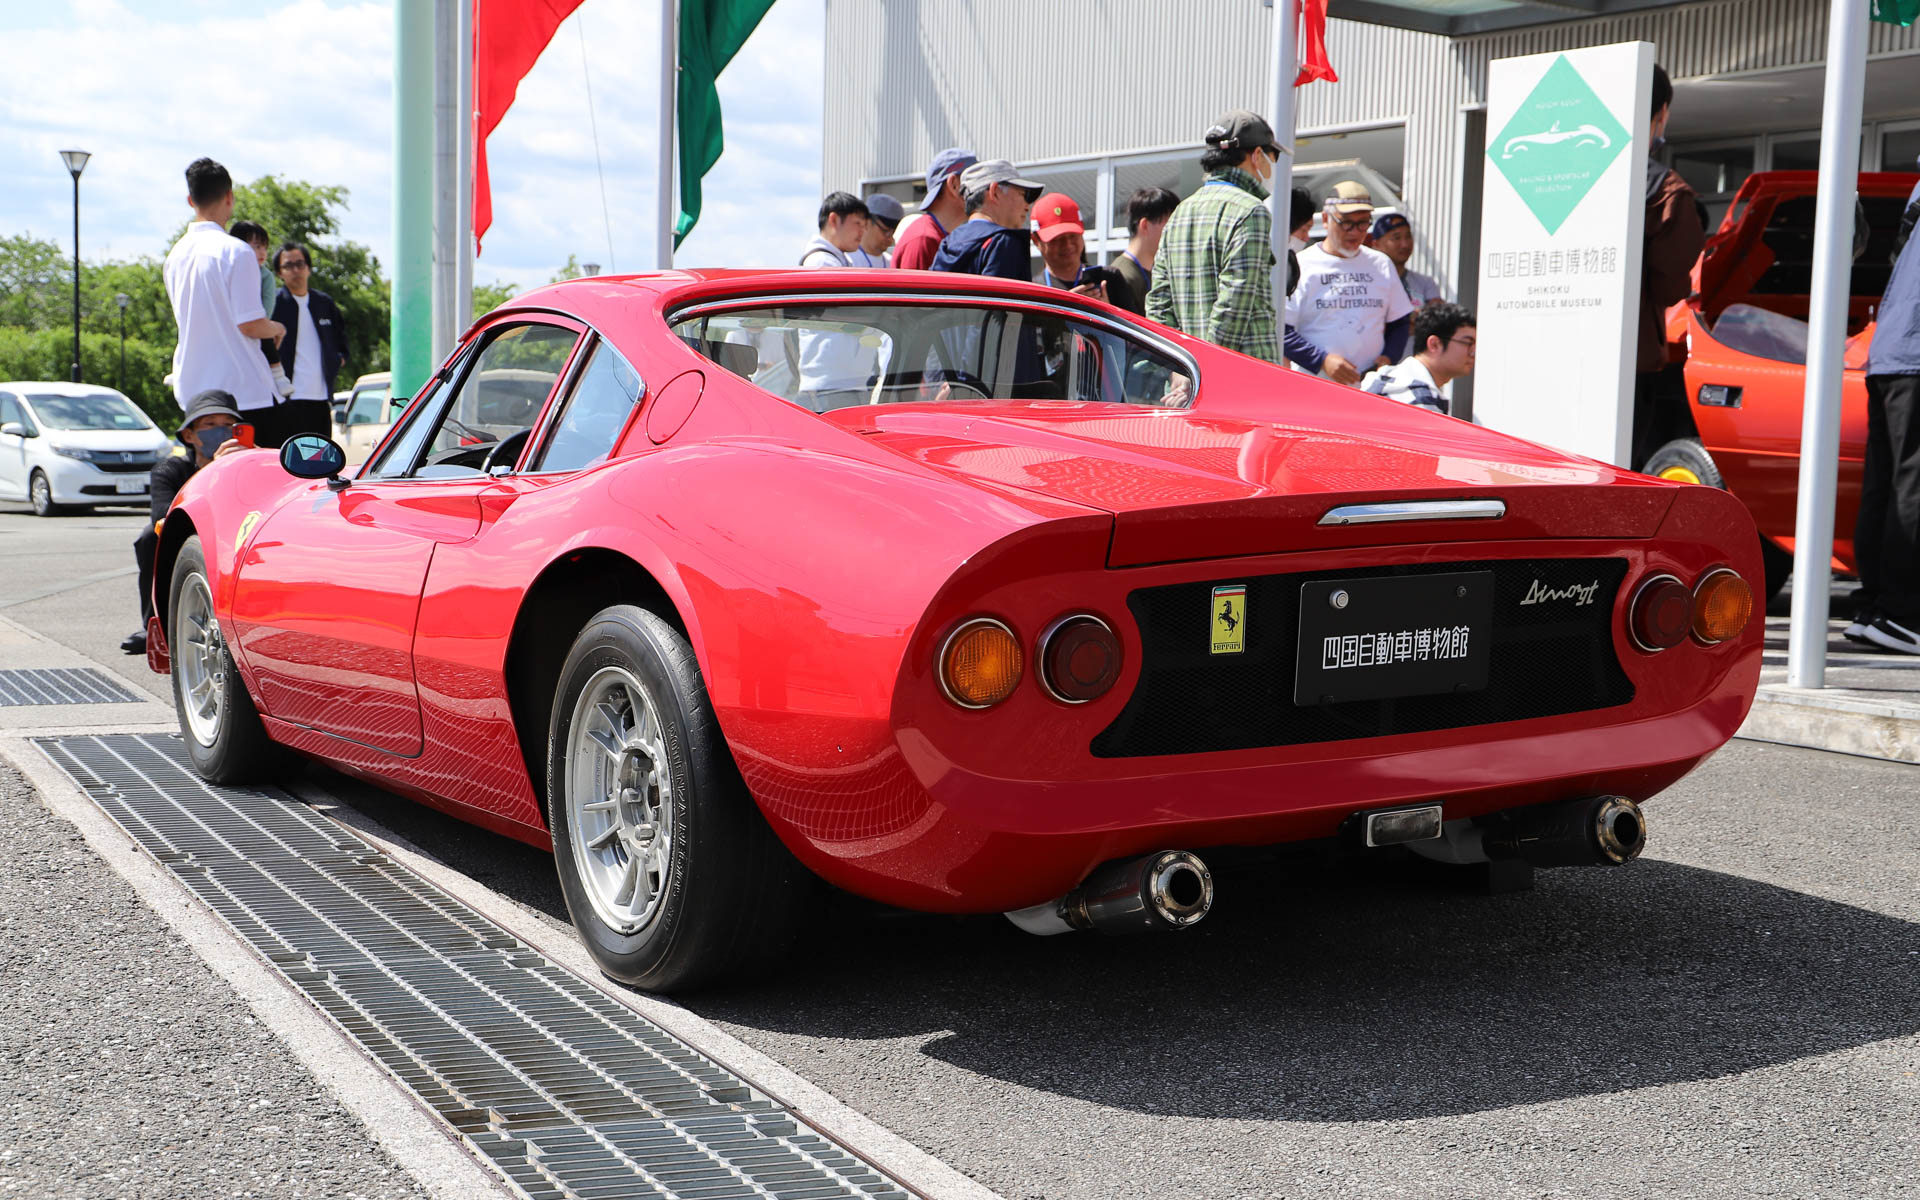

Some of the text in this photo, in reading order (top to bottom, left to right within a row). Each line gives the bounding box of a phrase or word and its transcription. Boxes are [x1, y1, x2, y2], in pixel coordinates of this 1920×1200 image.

[1488, 247, 1617, 278] 四国自動車博物館
[1320, 272, 1374, 285] UPSTAIRS
[1329, 284, 1369, 296] POETRY
[1527, 286, 1570, 295] SHIKOKU
[1496, 298, 1602, 310] AUTOMOBILE MUSEUM
[1213, 642, 1241, 651] Ferrari
[1322, 625, 1470, 670] 四国自動車博物館
